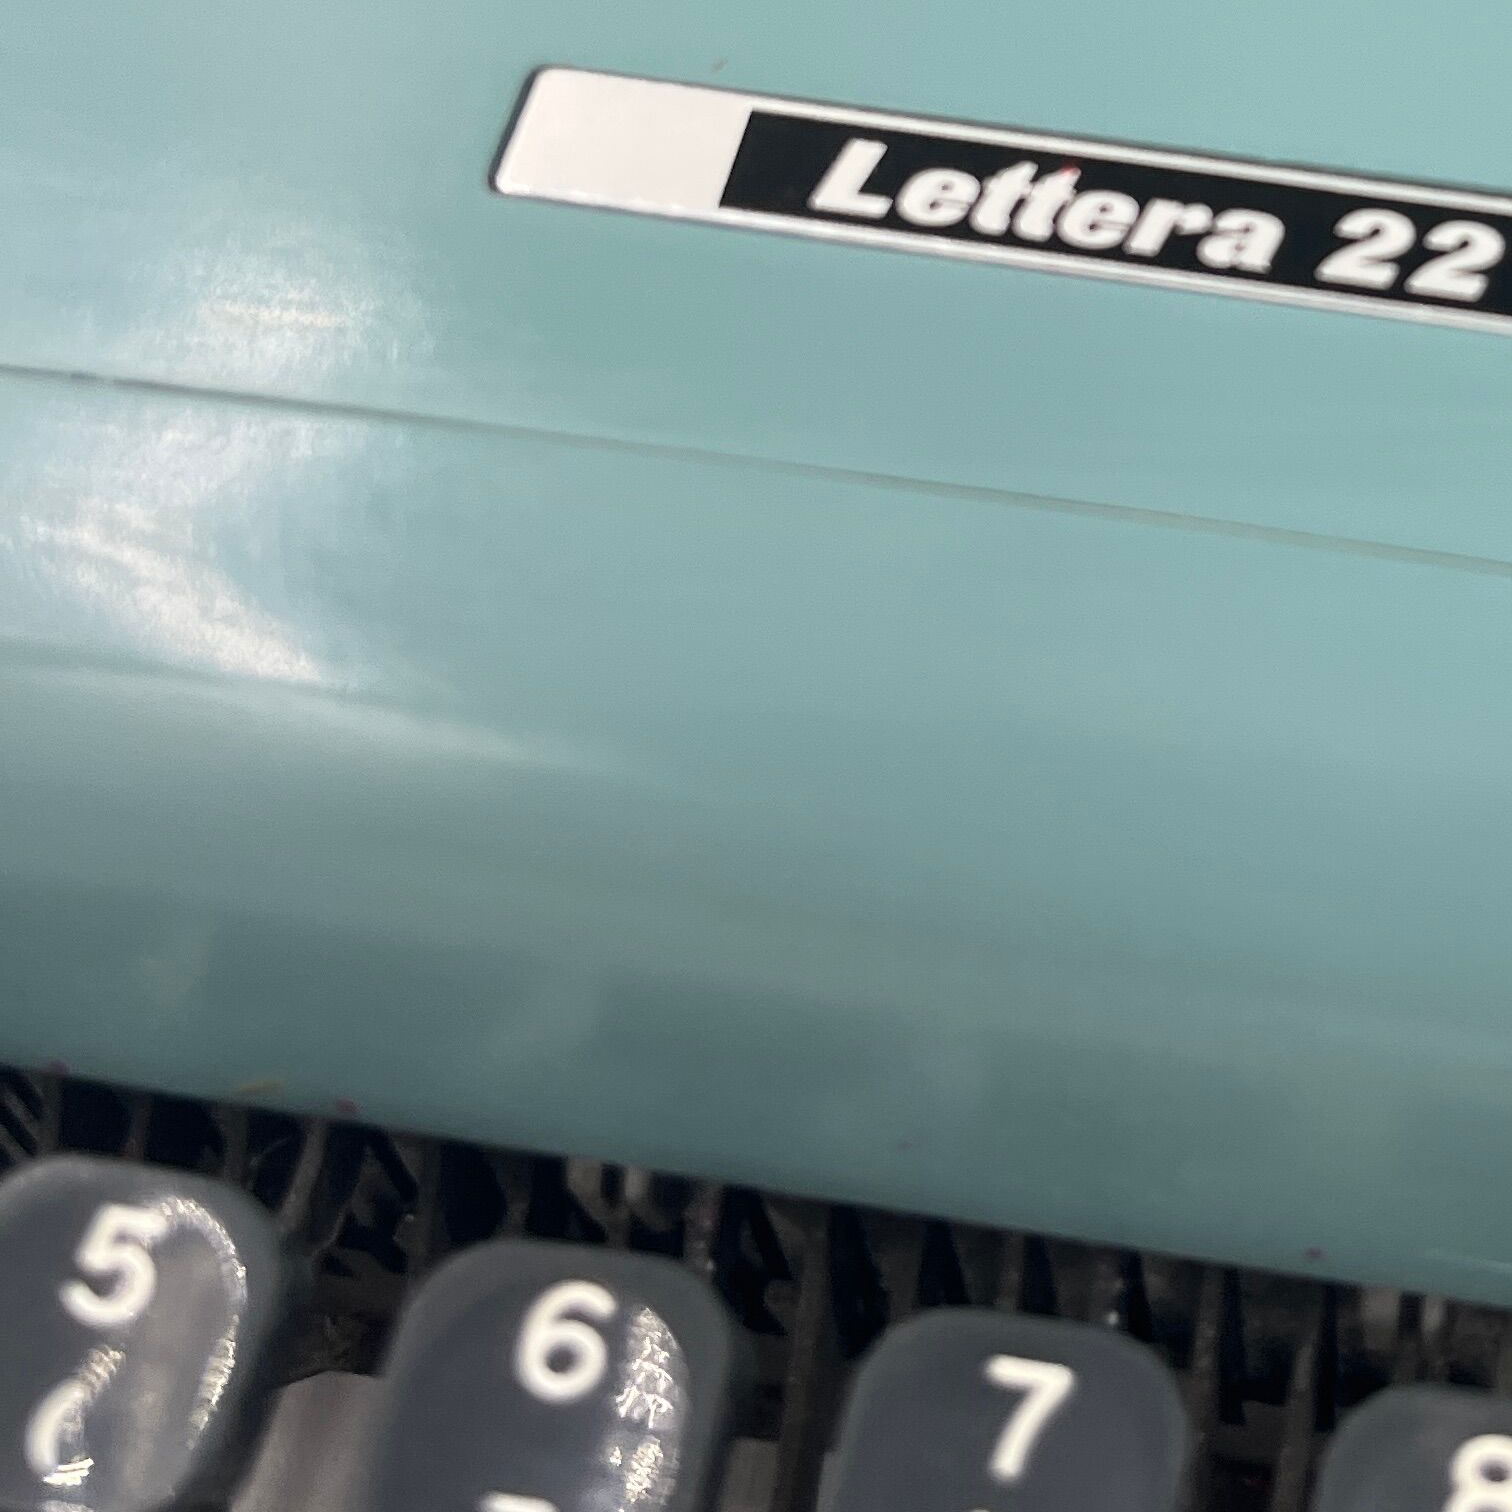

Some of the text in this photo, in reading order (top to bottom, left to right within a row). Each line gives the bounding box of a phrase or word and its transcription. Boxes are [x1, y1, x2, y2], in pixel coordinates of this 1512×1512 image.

[808, 138, 1506, 303] Lettera 22
[60, 1203, 168, 1329] 5
[515, 1279, 617, 1401] 6
[984, 1353, 1074, 1480] 7
